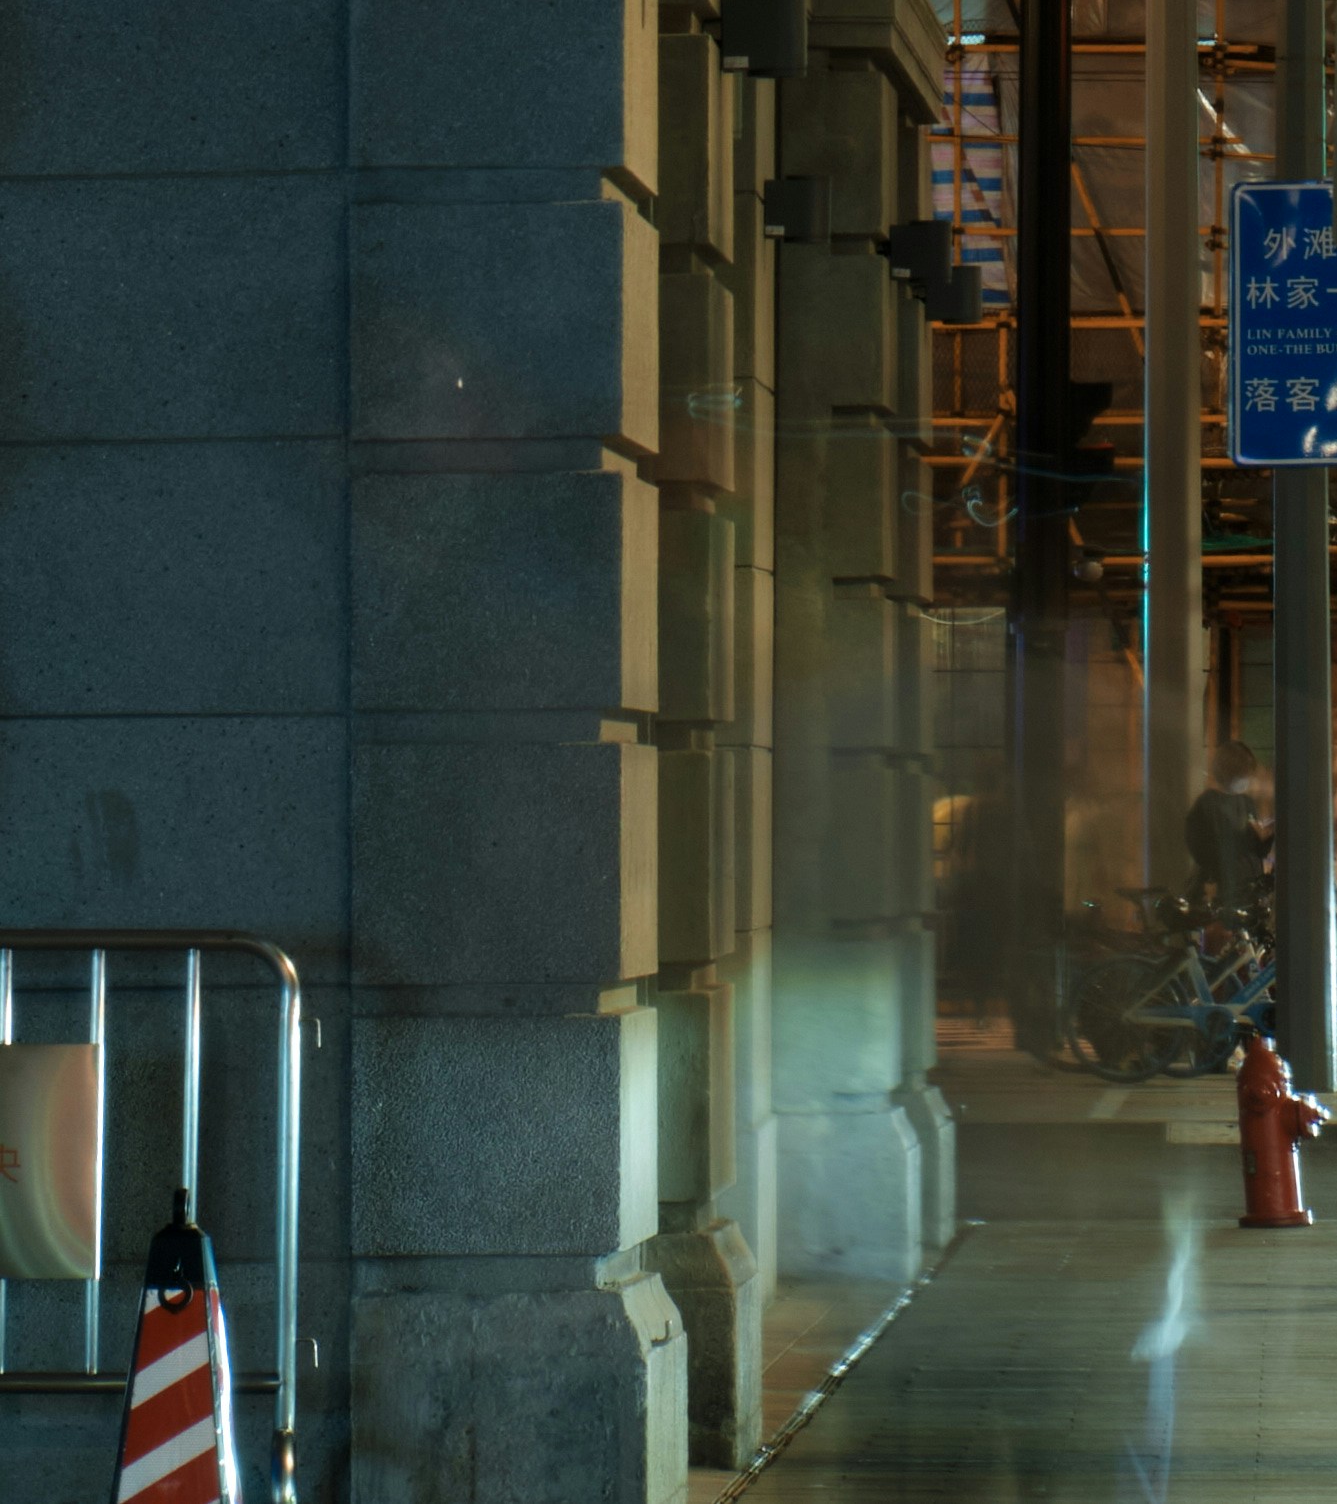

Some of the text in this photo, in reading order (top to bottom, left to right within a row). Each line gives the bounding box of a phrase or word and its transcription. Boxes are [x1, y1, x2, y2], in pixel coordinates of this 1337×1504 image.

[1263, 226, 1337, 261] 外滩
[1247, 328, 1272, 340] LIN
[1277, 327, 1332, 339] FAMILY
[1246, 344, 1312, 355] ONE-THE
